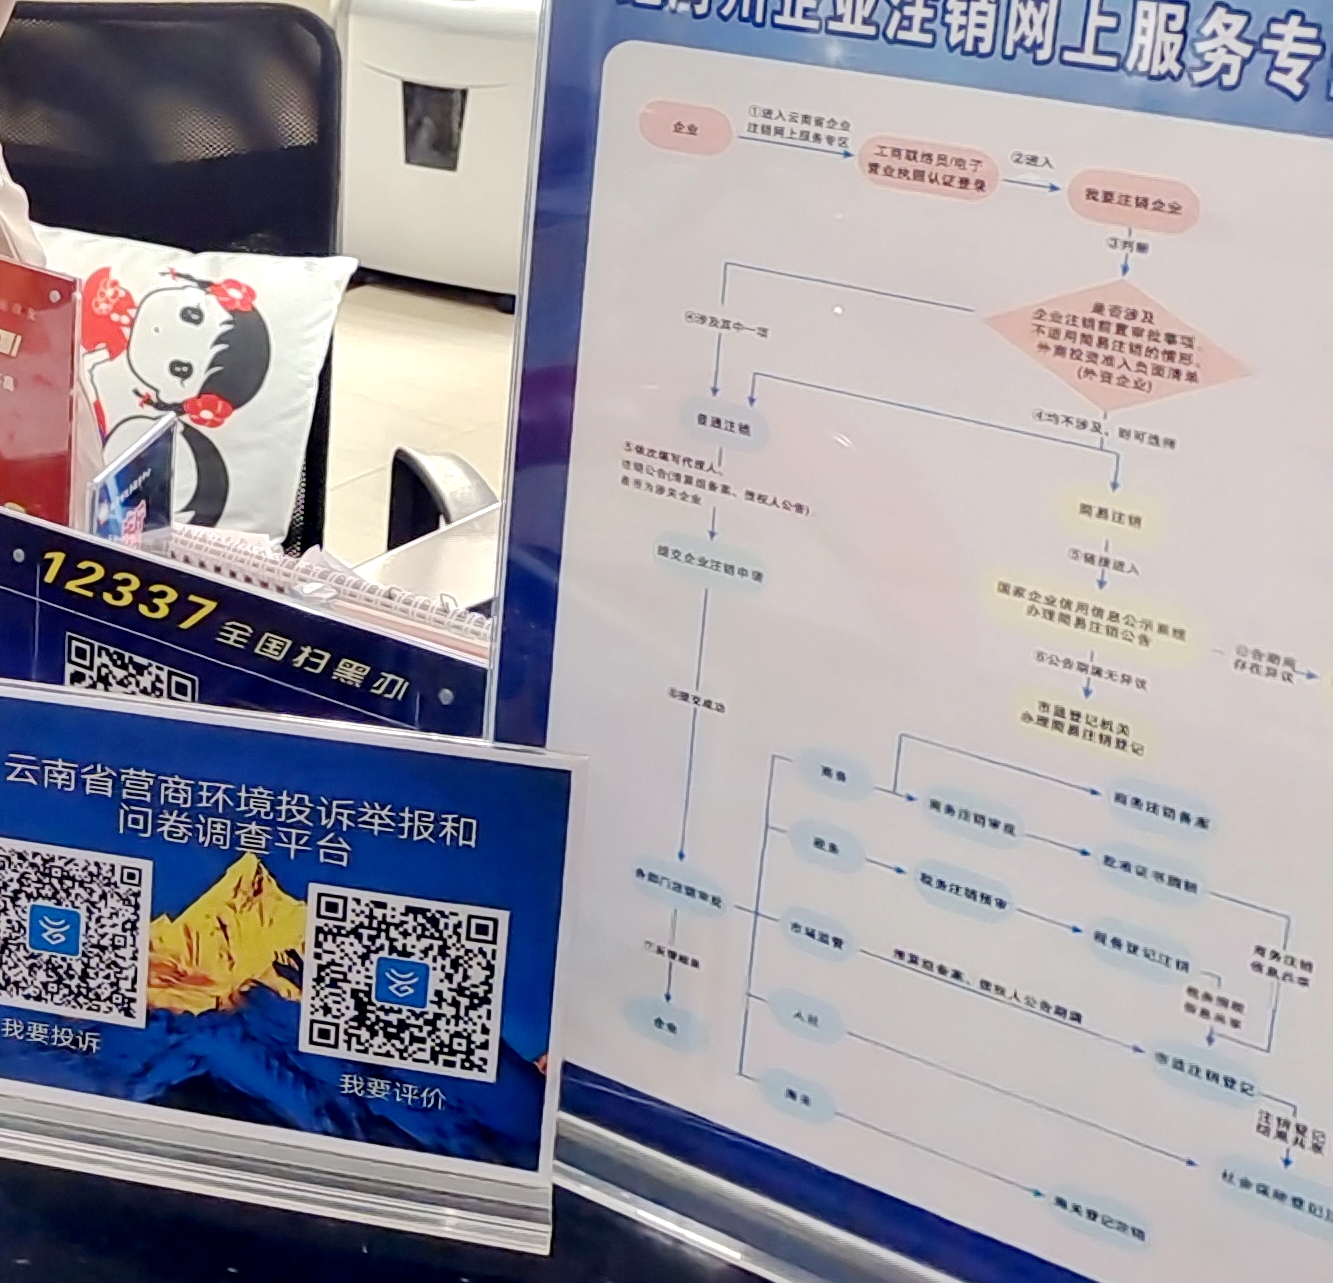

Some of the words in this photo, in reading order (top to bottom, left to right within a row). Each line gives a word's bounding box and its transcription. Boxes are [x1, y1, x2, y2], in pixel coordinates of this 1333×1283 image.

[671, 120, 699, 136] 企业
[1085, 187, 1183, 215] 我要注销企业
[1079, 502, 1142, 529] 简易注销
[41, 550, 219, 631] 12337
[215, 620, 410, 703] 全国扫黑办
[4, 752, 478, 850] 云南省营商环境投诉举报和
[118, 803, 354, 868] 问卷调查平台
[0, 1018, 102, 1055] 我要投诉
[338, 1073, 448, 1112] 我要评价
